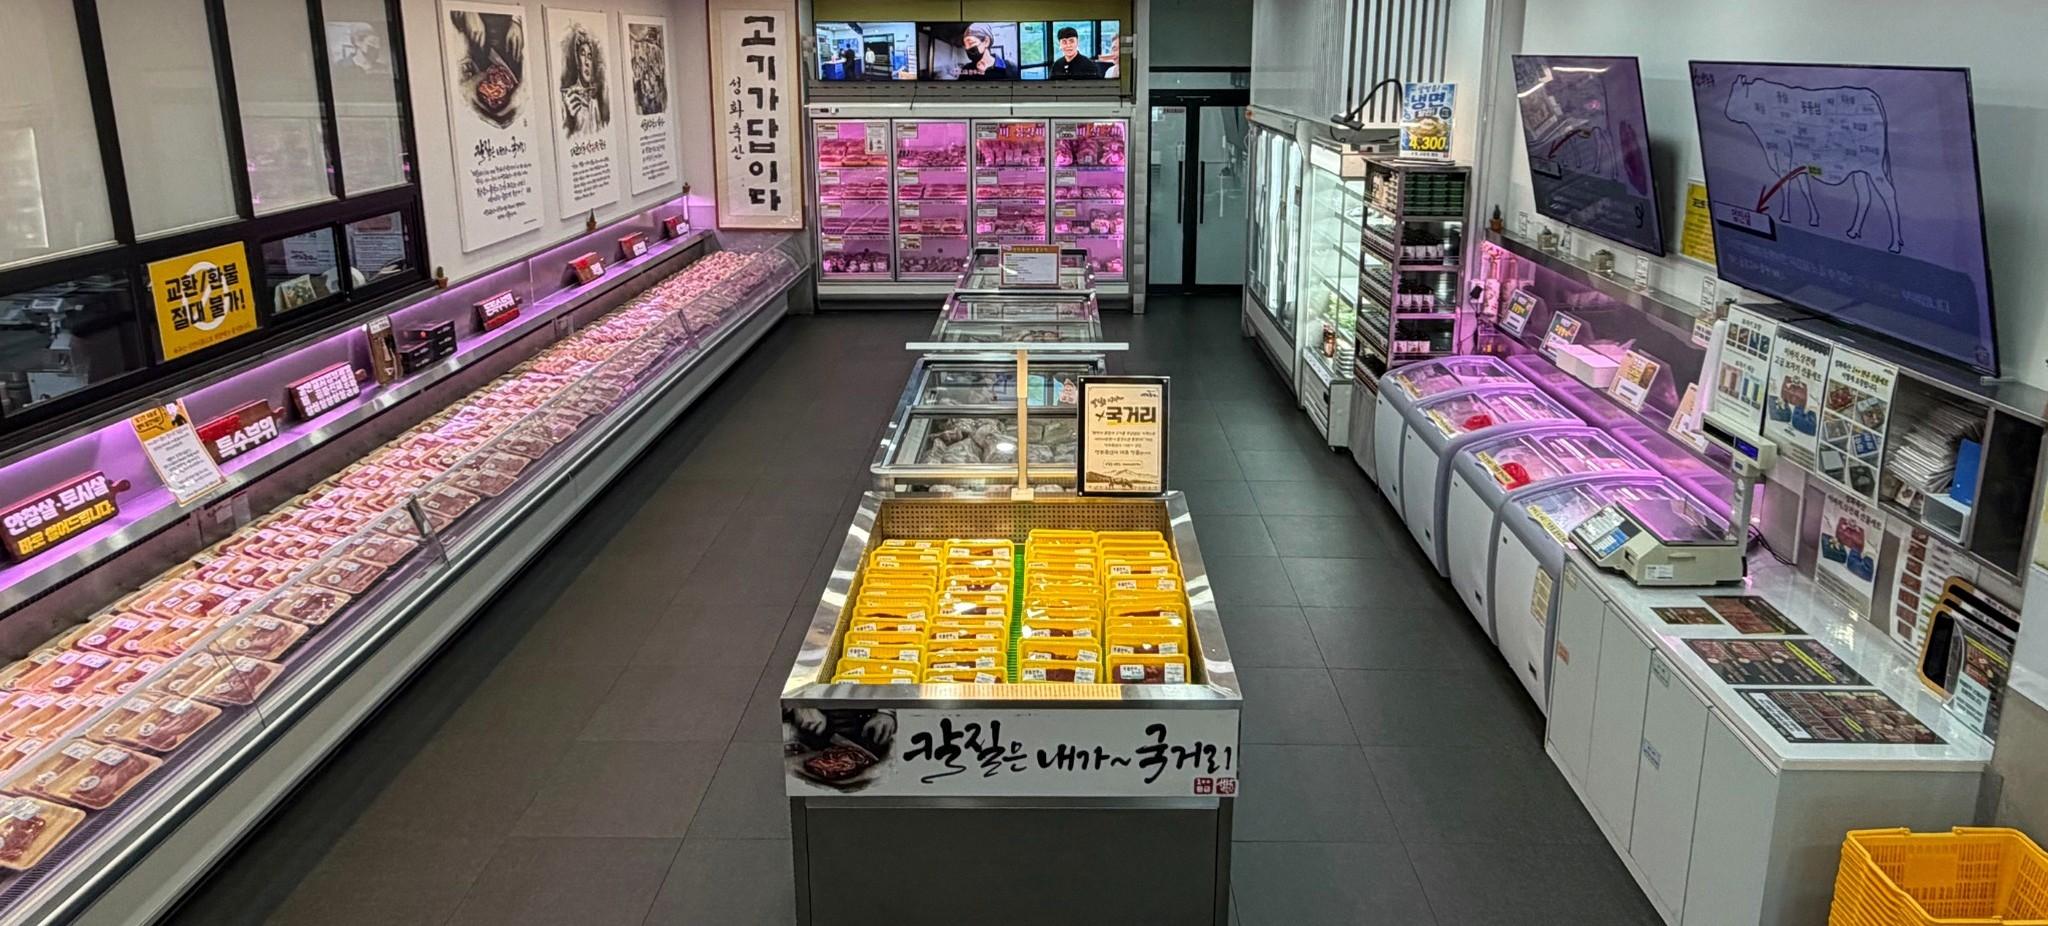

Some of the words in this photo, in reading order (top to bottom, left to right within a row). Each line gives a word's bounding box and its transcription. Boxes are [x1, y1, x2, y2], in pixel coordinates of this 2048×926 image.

[729, 77, 744, 159] 성화축산
[1411, 93, 1446, 110] 냉면
[165, 262, 239, 302] 교환/환불
[171, 300, 206, 331] 절대
[209, 288, 246, 319] 불가!
[1106, 406, 1156, 423] 국거리
[215, 416, 278, 458] 특수부위
[17, 531, 46, 555] 바로
[903, 717, 1028, 784] 칼질은
[1036, 744, 1131, 773] 내가~
[1134, 722, 1233, 784] 국거리
